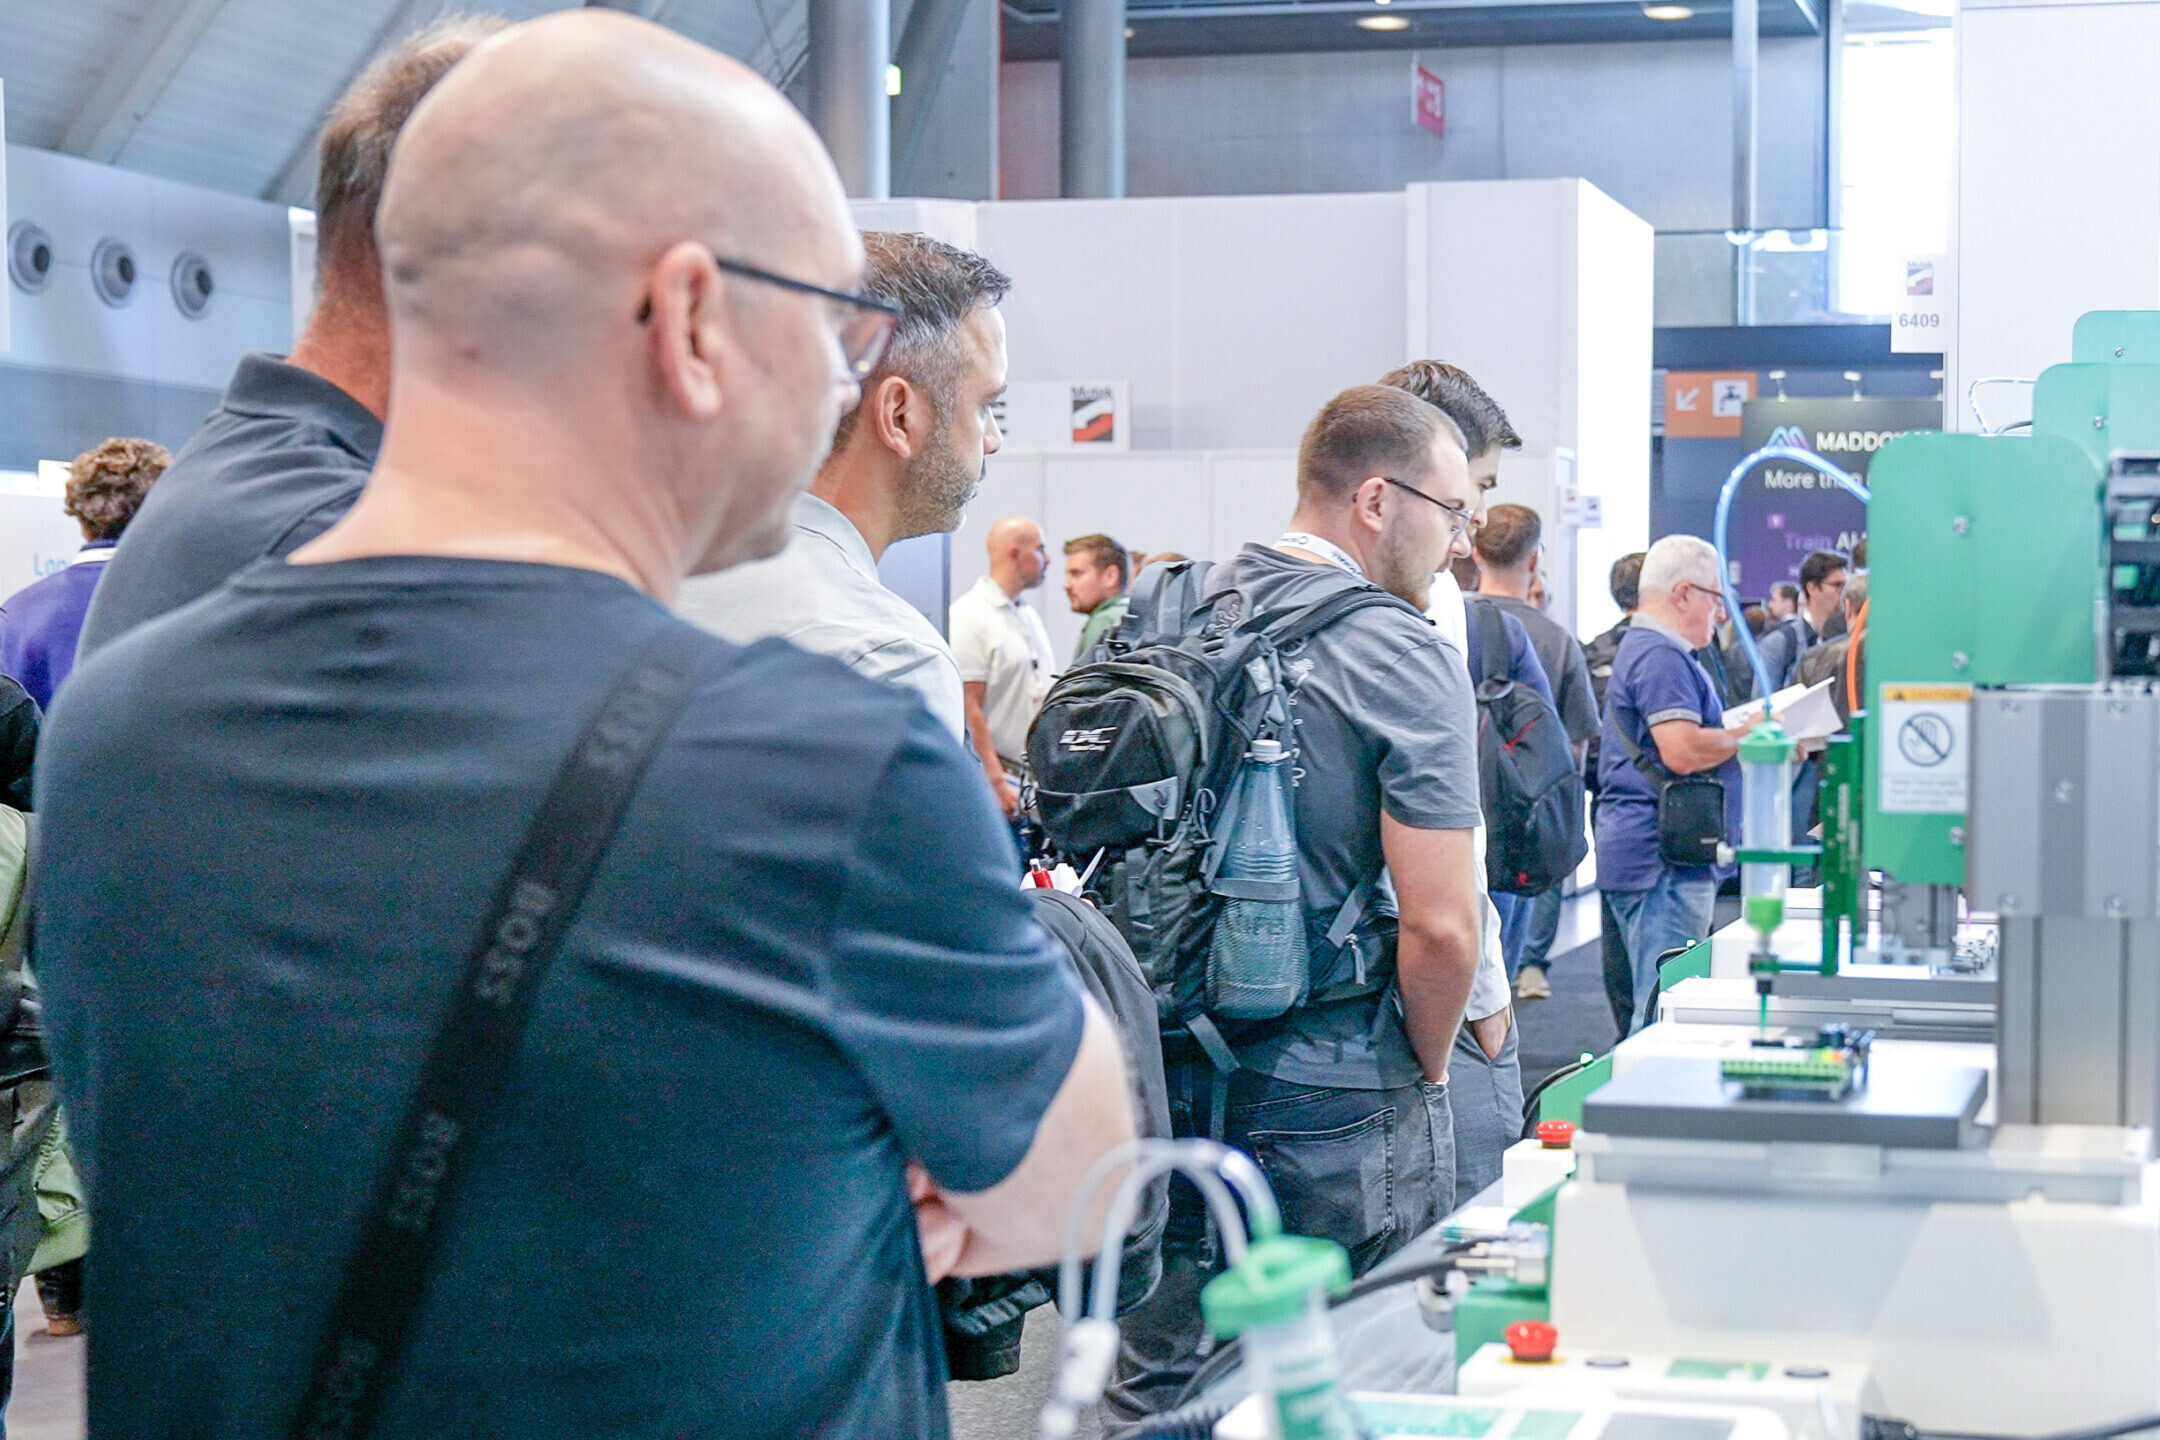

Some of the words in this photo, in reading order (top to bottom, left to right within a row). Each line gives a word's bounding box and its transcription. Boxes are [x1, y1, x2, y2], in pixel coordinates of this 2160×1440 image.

[1899, 313, 1940, 328] 6409
[1816, 431, 1909, 452] MADDO
[1764, 468, 1816, 490] More
[476, 880, 556, 1006] BOSS
